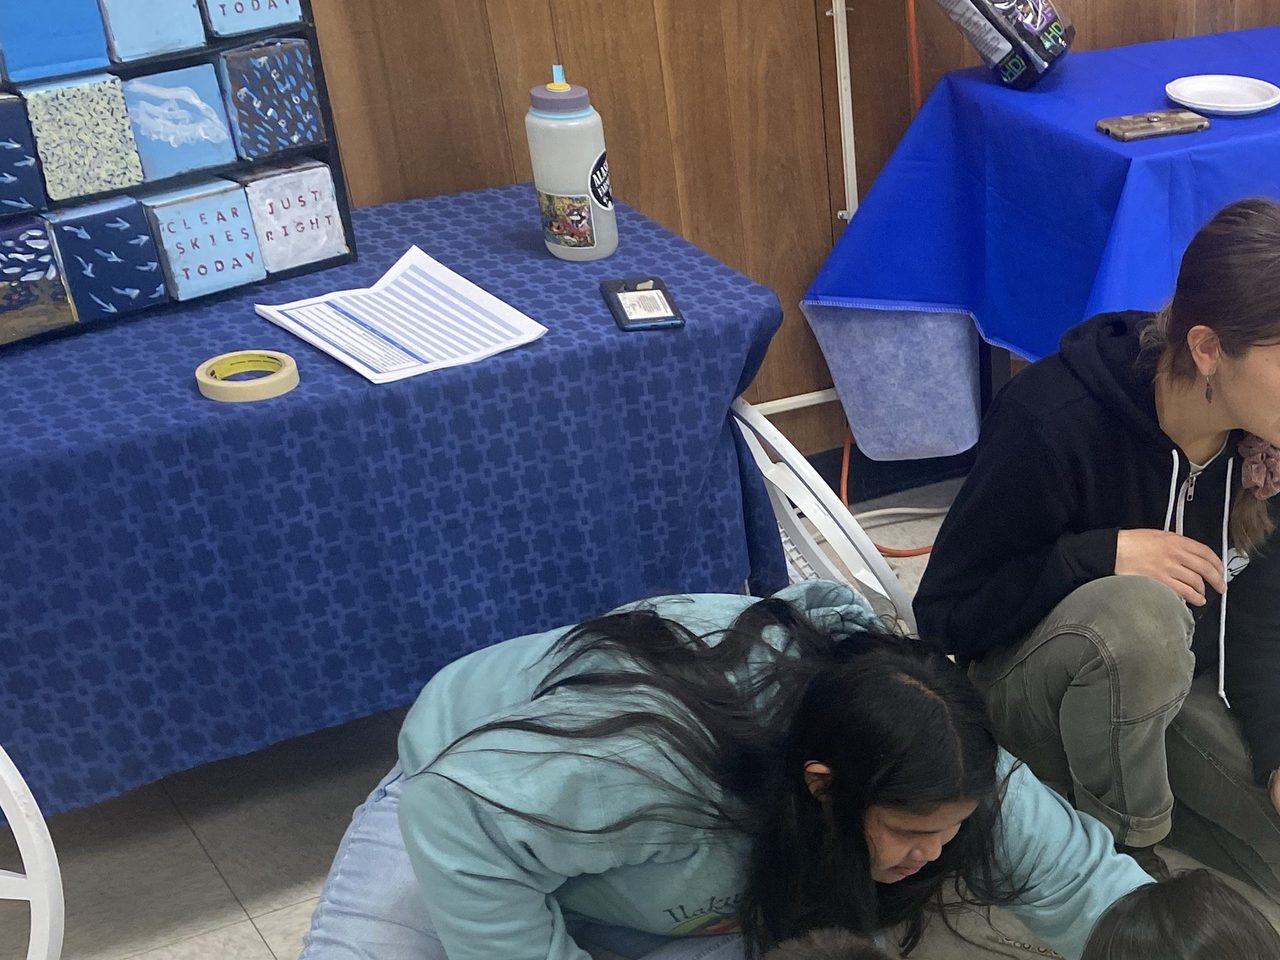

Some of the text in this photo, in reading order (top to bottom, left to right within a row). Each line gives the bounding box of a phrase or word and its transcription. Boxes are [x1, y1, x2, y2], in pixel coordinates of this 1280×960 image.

[267, 190, 319, 216] JUST
[166, 207, 240, 234] CLEAR
[265, 215, 333, 242] RIGHT
[175, 227, 250, 255] SKIES
[182, 251, 255, 281] TODAY
